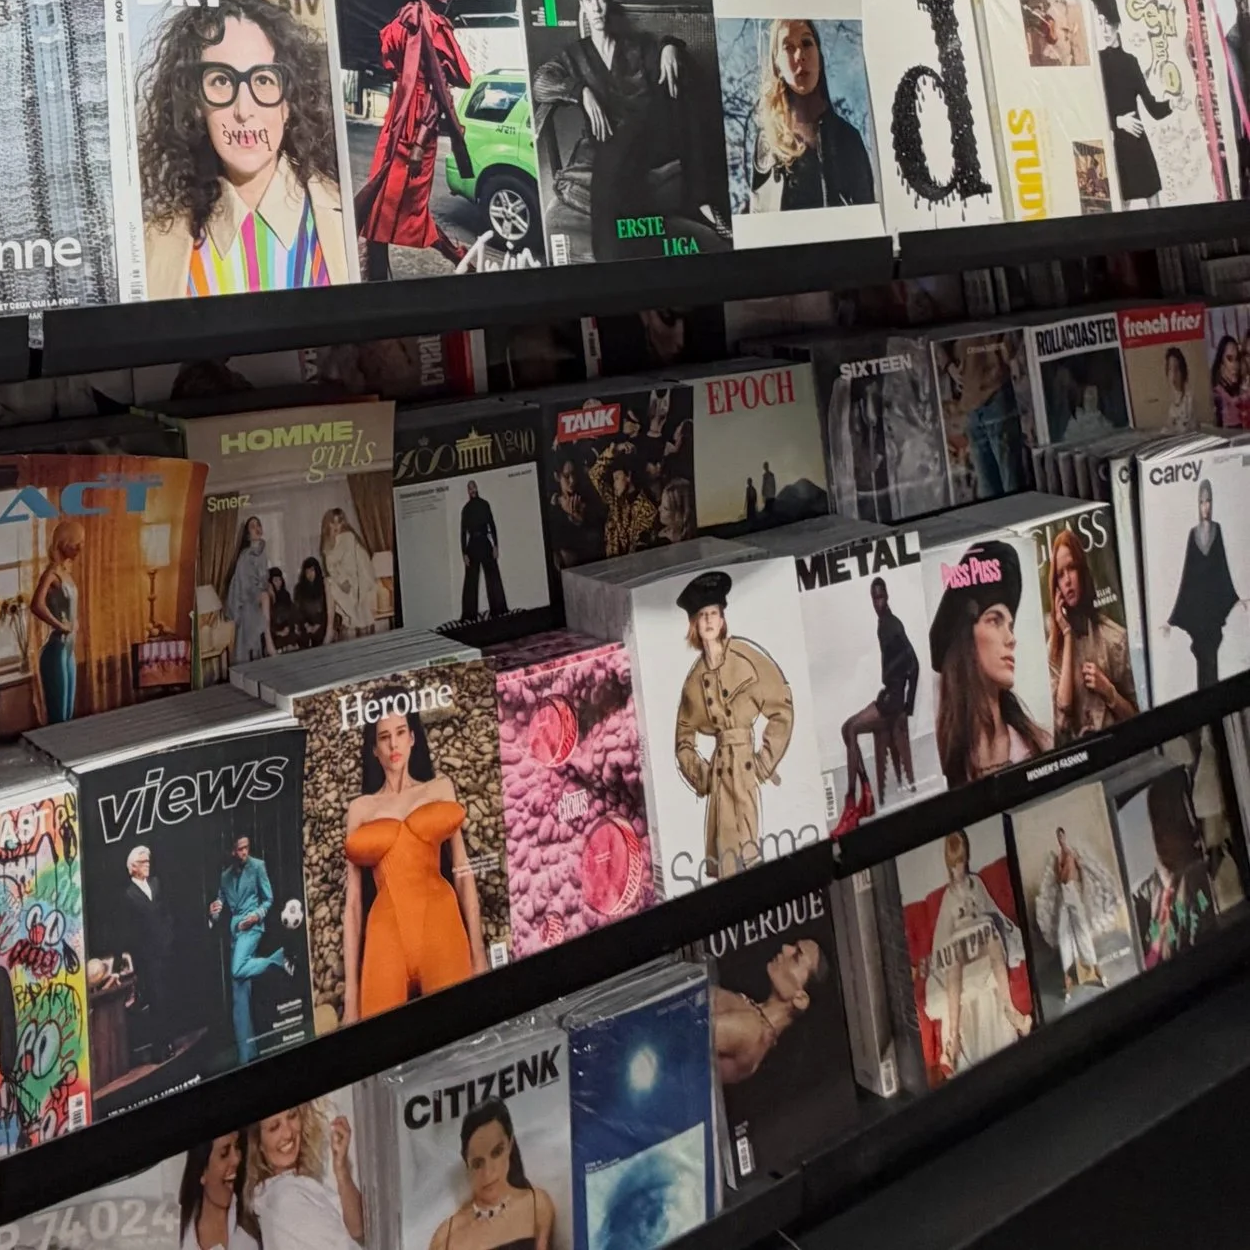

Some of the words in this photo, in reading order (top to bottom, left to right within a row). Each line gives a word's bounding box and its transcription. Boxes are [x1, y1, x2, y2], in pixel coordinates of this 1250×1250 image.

[616, 216, 665, 240] ERSTE
[662, 237, 700, 257] LIGA
[58, 297, 79, 306] FONT
[1035, 317, 1118, 357] ROLLACOASTER
[1122, 311, 1169, 339] french
[1170, 309, 1202, 332] fries
[839, 354, 913, 380] SIXTEEN
[706, 370, 796, 415] EPOCH
[561, 406, 617, 435] TANK
[220, 420, 354, 456] HOMME
[305, 429, 376, 484] girls
[1150, 459, 1204, 486] carcy
[207, 494, 250, 513] Smerz
[796, 531, 922, 593] METAL
[970, 556, 1002, 585] Puss
[339, 679, 454, 731] Heroine
[1026, 761, 1060, 782] WOMEN'S
[1059, 750, 1090, 769] FASHION
[98, 755, 290, 845] views
[710, 888, 826, 958] OVERDUE
